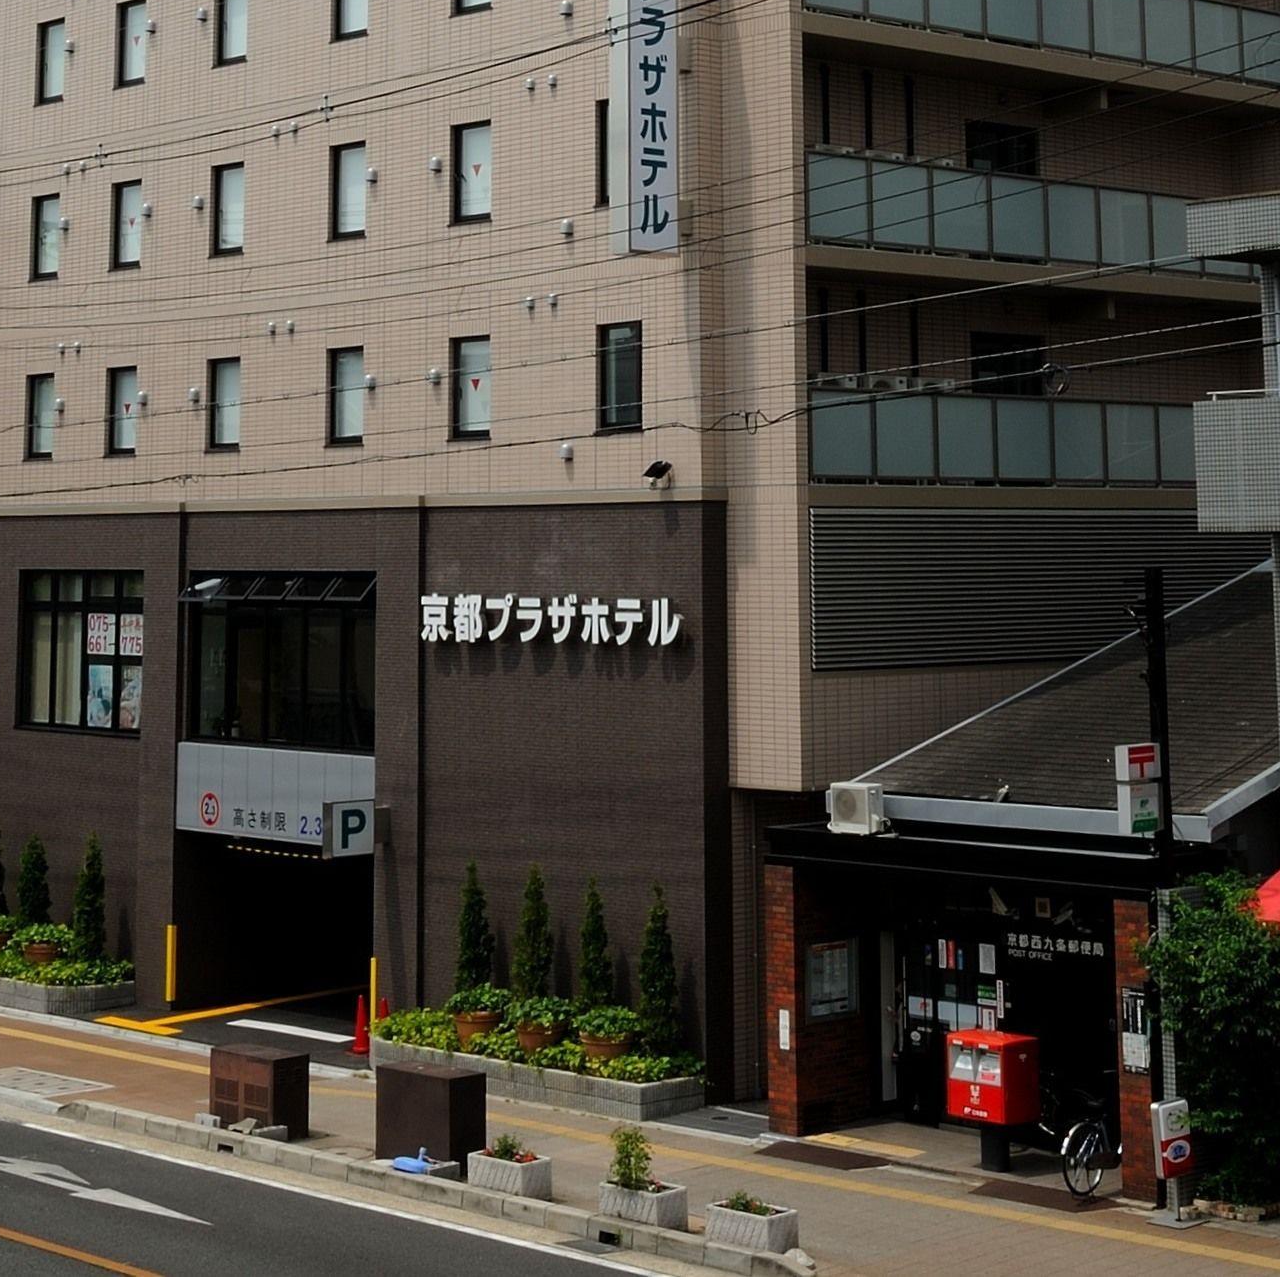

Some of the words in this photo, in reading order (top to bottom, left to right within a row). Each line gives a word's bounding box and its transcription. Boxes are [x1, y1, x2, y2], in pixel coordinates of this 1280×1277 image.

[420, 592, 682, 647] 京都プラザホテル
[232, 808, 287, 833] 高さ制限
[340, 808, 367, 850] P
[1007, 932, 1104, 957] 京都西九条郵便局
[1008, 948, 1027, 958] POST
[1028, 950, 1053, 961] OFFICE
